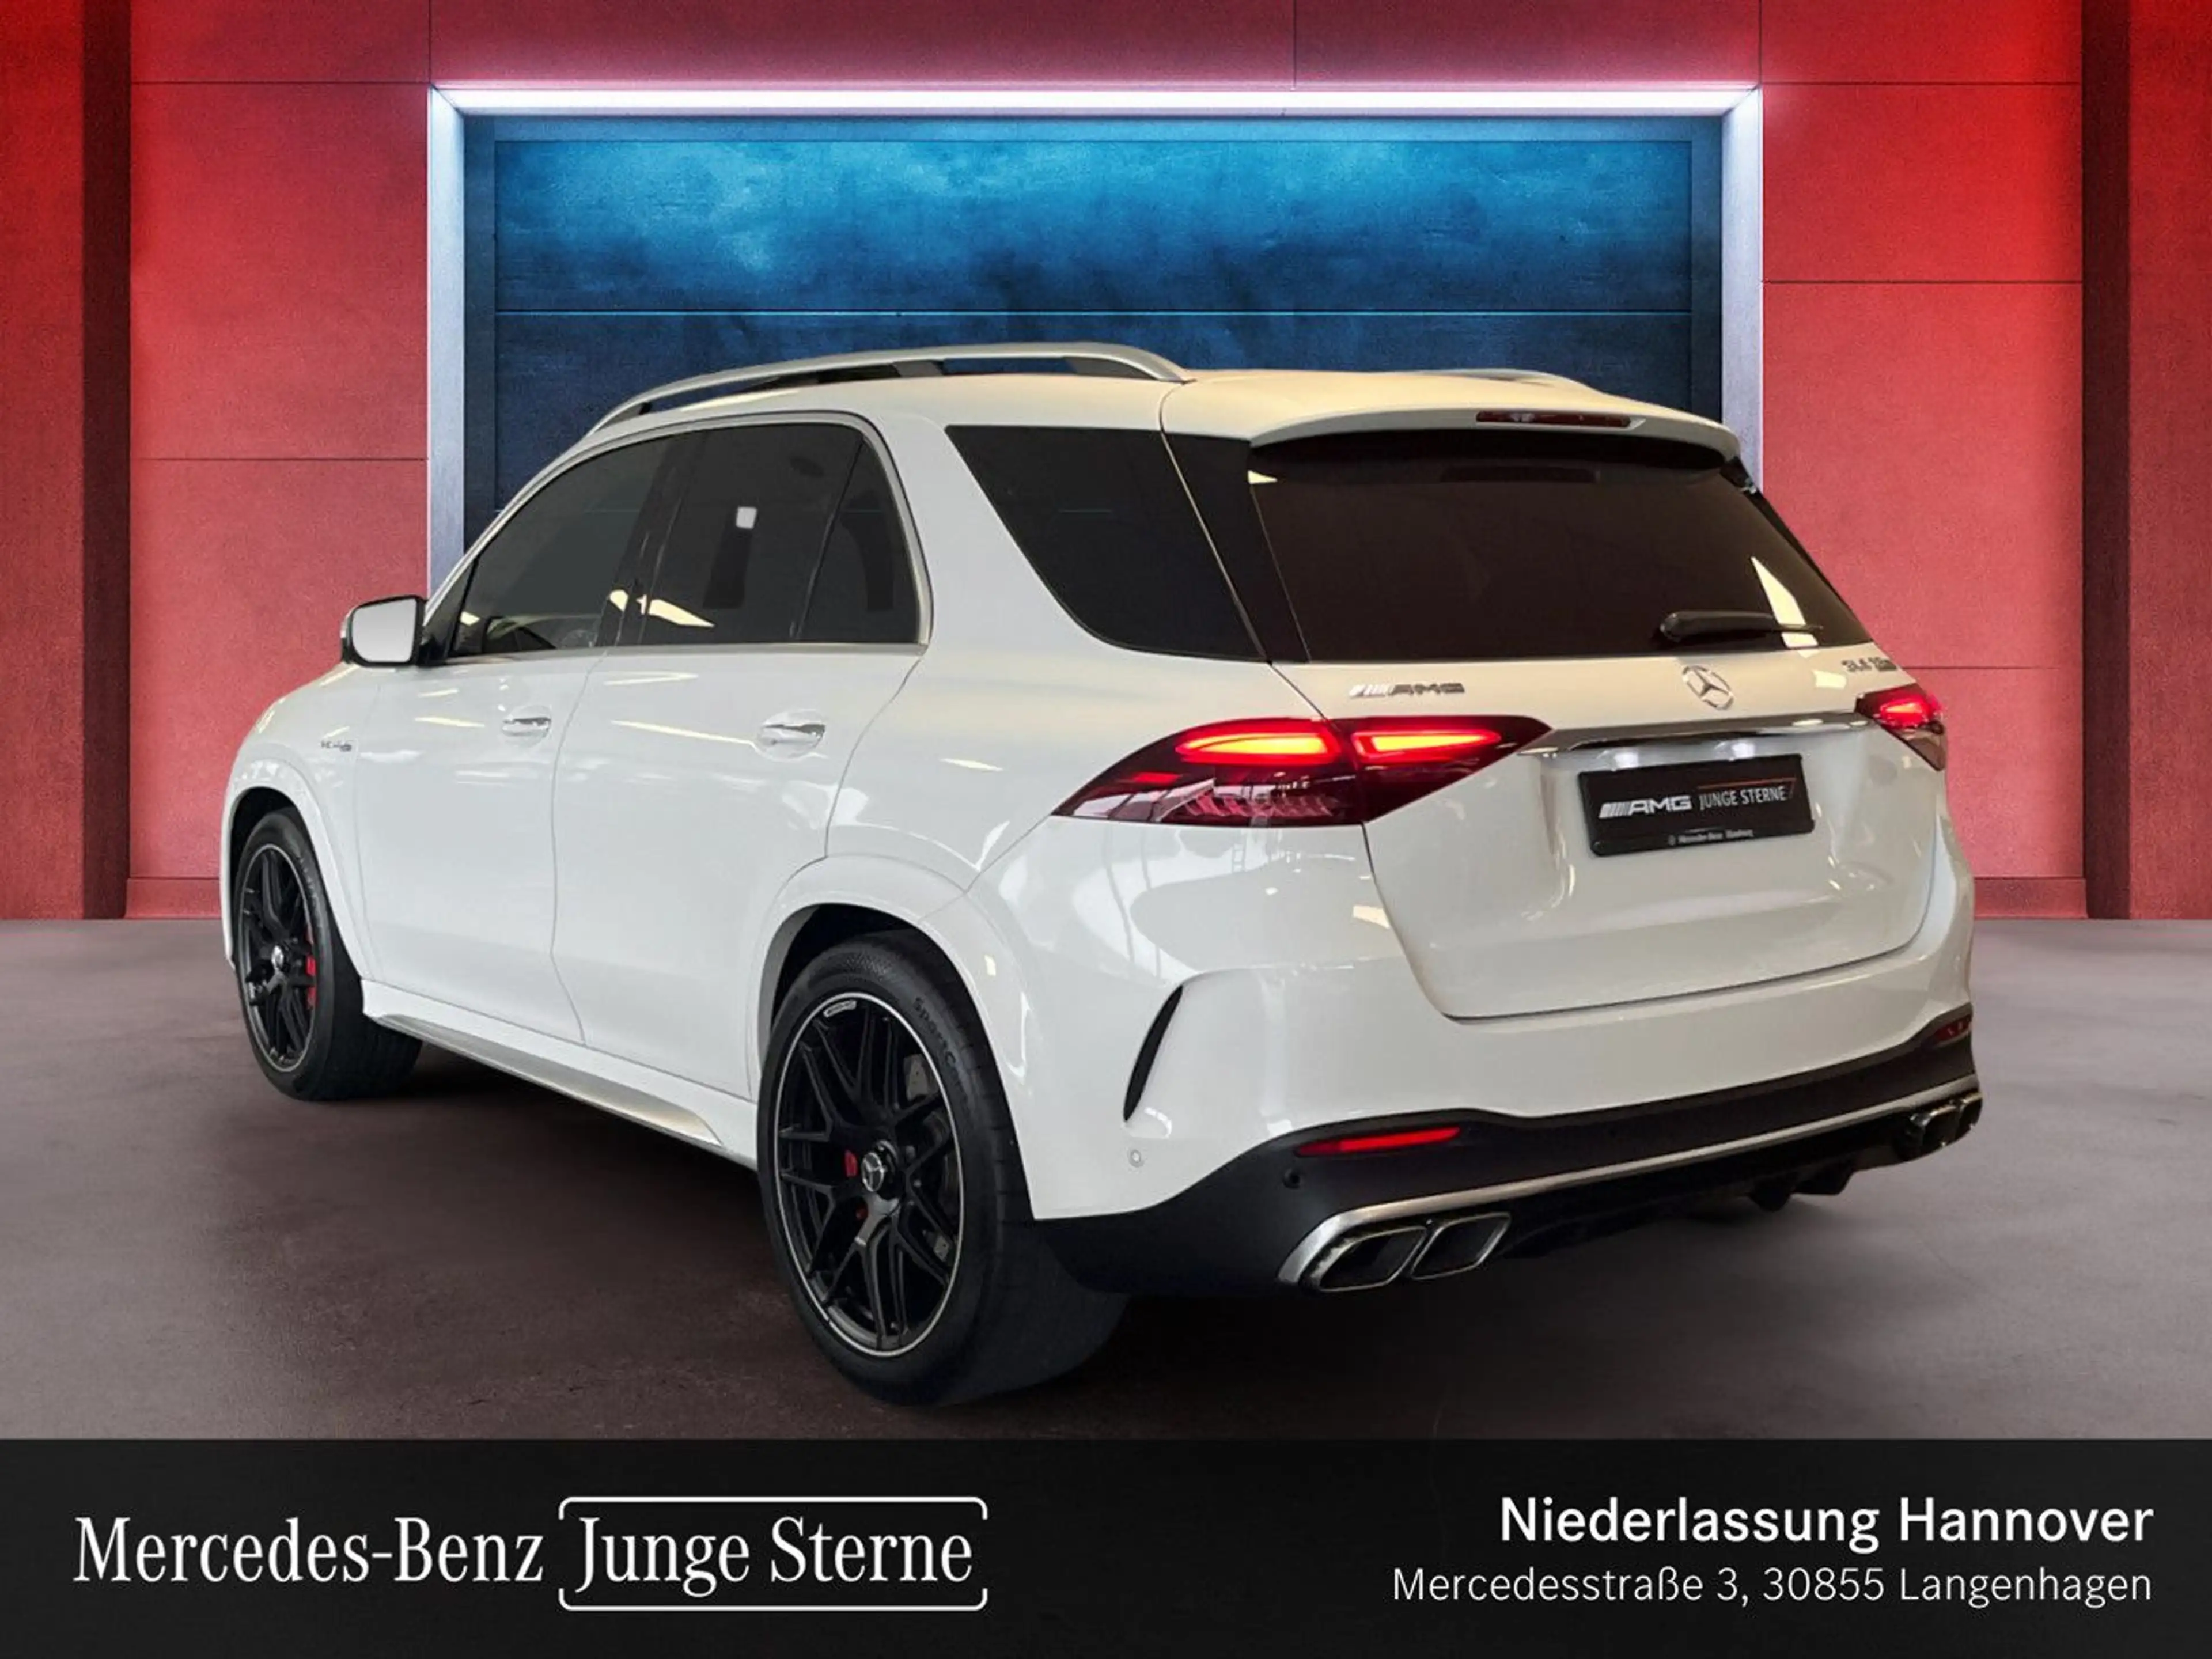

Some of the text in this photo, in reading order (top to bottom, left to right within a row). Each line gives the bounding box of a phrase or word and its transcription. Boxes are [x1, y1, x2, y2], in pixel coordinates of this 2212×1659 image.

[1626, 785, 1786, 815] AMG JUNGE STERNE
